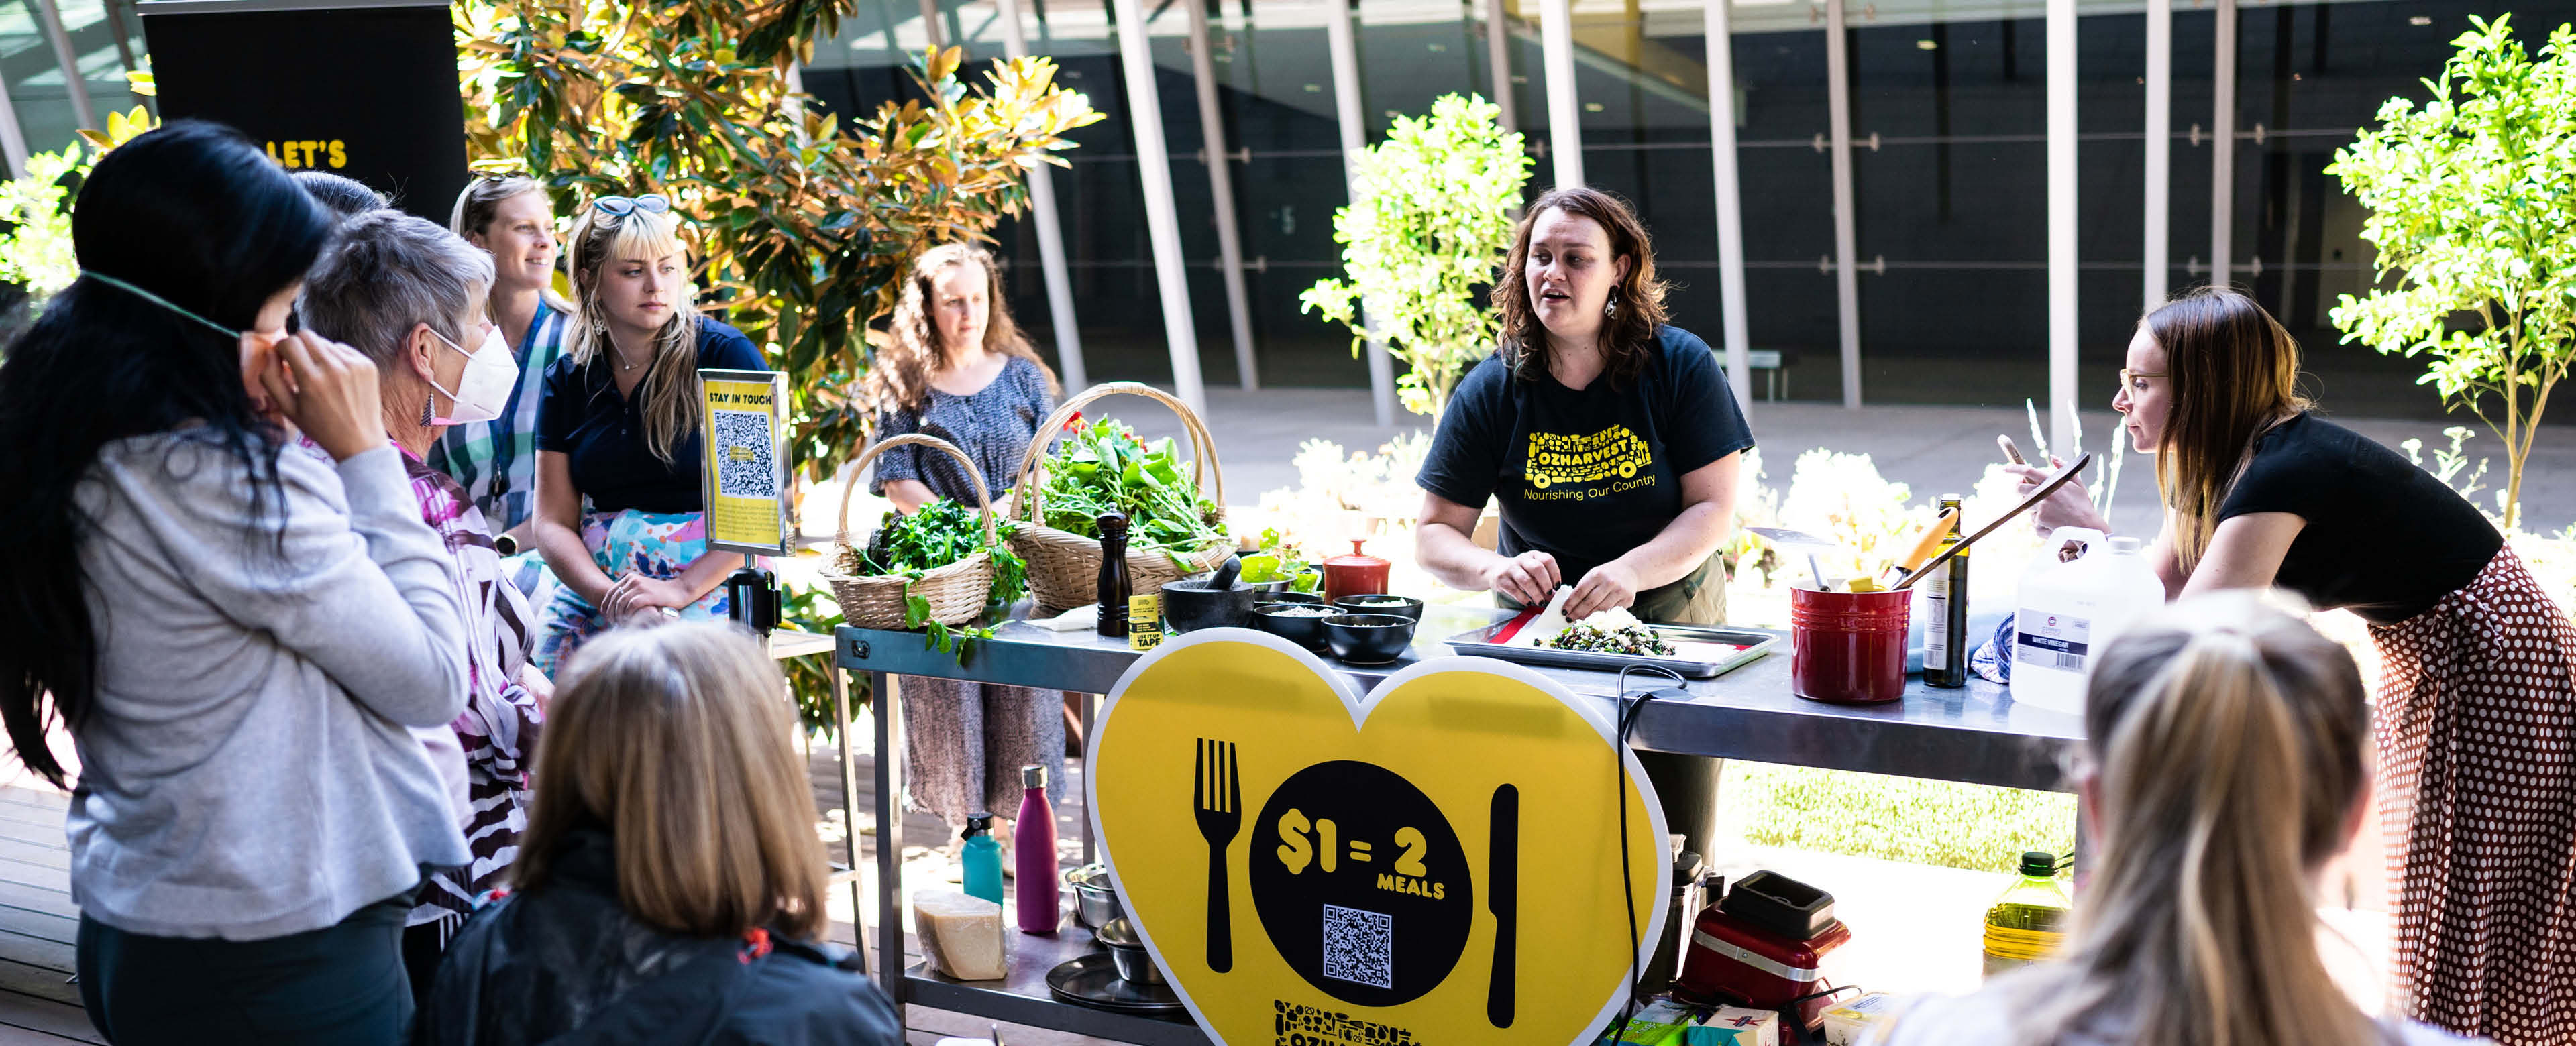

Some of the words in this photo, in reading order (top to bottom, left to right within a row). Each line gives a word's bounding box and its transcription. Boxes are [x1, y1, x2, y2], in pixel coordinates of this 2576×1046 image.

[266, 140, 347, 168] LET'S
[710, 392, 729, 402] STAY
[732, 394, 741, 404] IN
[743, 394, 772, 405] TOUCH
[1538, 439, 1627, 466] OZHARVEST
[1524, 489, 1584, 502] Nourishing
[1588, 487, 1609, 498] Our
[1613, 474, 1656, 493] Country
[1137, 638, 1161, 647] TAPE
[2032, 636, 2048, 645] WHITE
[2048, 639, 2069, 648] VINEGAR
[1277, 808, 1337, 875] $1
[1395, 827, 1427, 877] 2
[1377, 873, 1444, 900] MEALS
